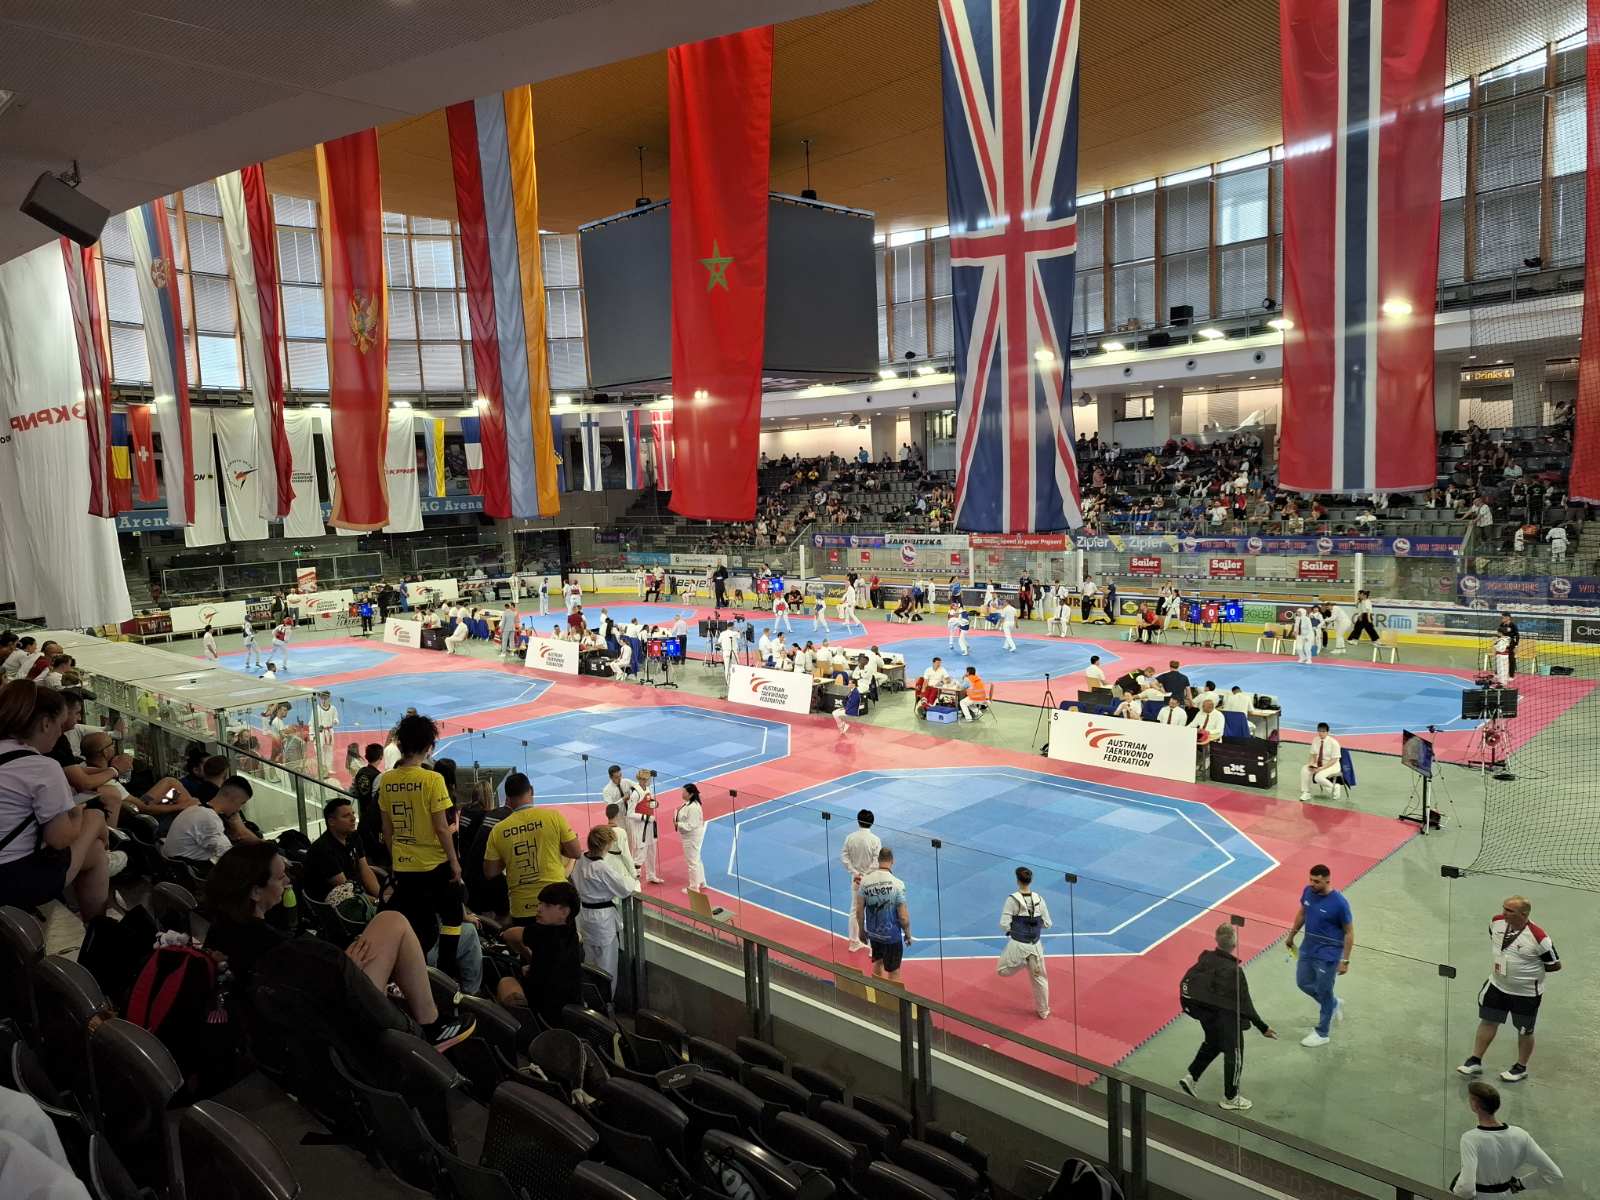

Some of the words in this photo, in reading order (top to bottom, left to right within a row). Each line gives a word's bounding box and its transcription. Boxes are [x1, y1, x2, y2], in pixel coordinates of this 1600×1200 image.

[444, 500, 484, 511] Arena
[1077, 536, 1109, 550] Zipfer
[1129, 536, 1163, 550] Zipfer
[1131, 558, 1159, 568] Sailer
[1212, 559, 1242, 570] Sailer
[1301, 560, 1335, 571] Sailer
[1208, 609, 1215, 617] 0
[1230, 608, 1236, 616] 0
[1053, 713, 1059, 721] 5
[1107, 739, 1148, 752] AUSTRIAN
[1105, 746, 1154, 760] TAEKWONDO
[1103, 754, 1151, 768] FEDERATION
[385, 782, 422, 793] COACH
[503, 820, 543, 838] COACH
